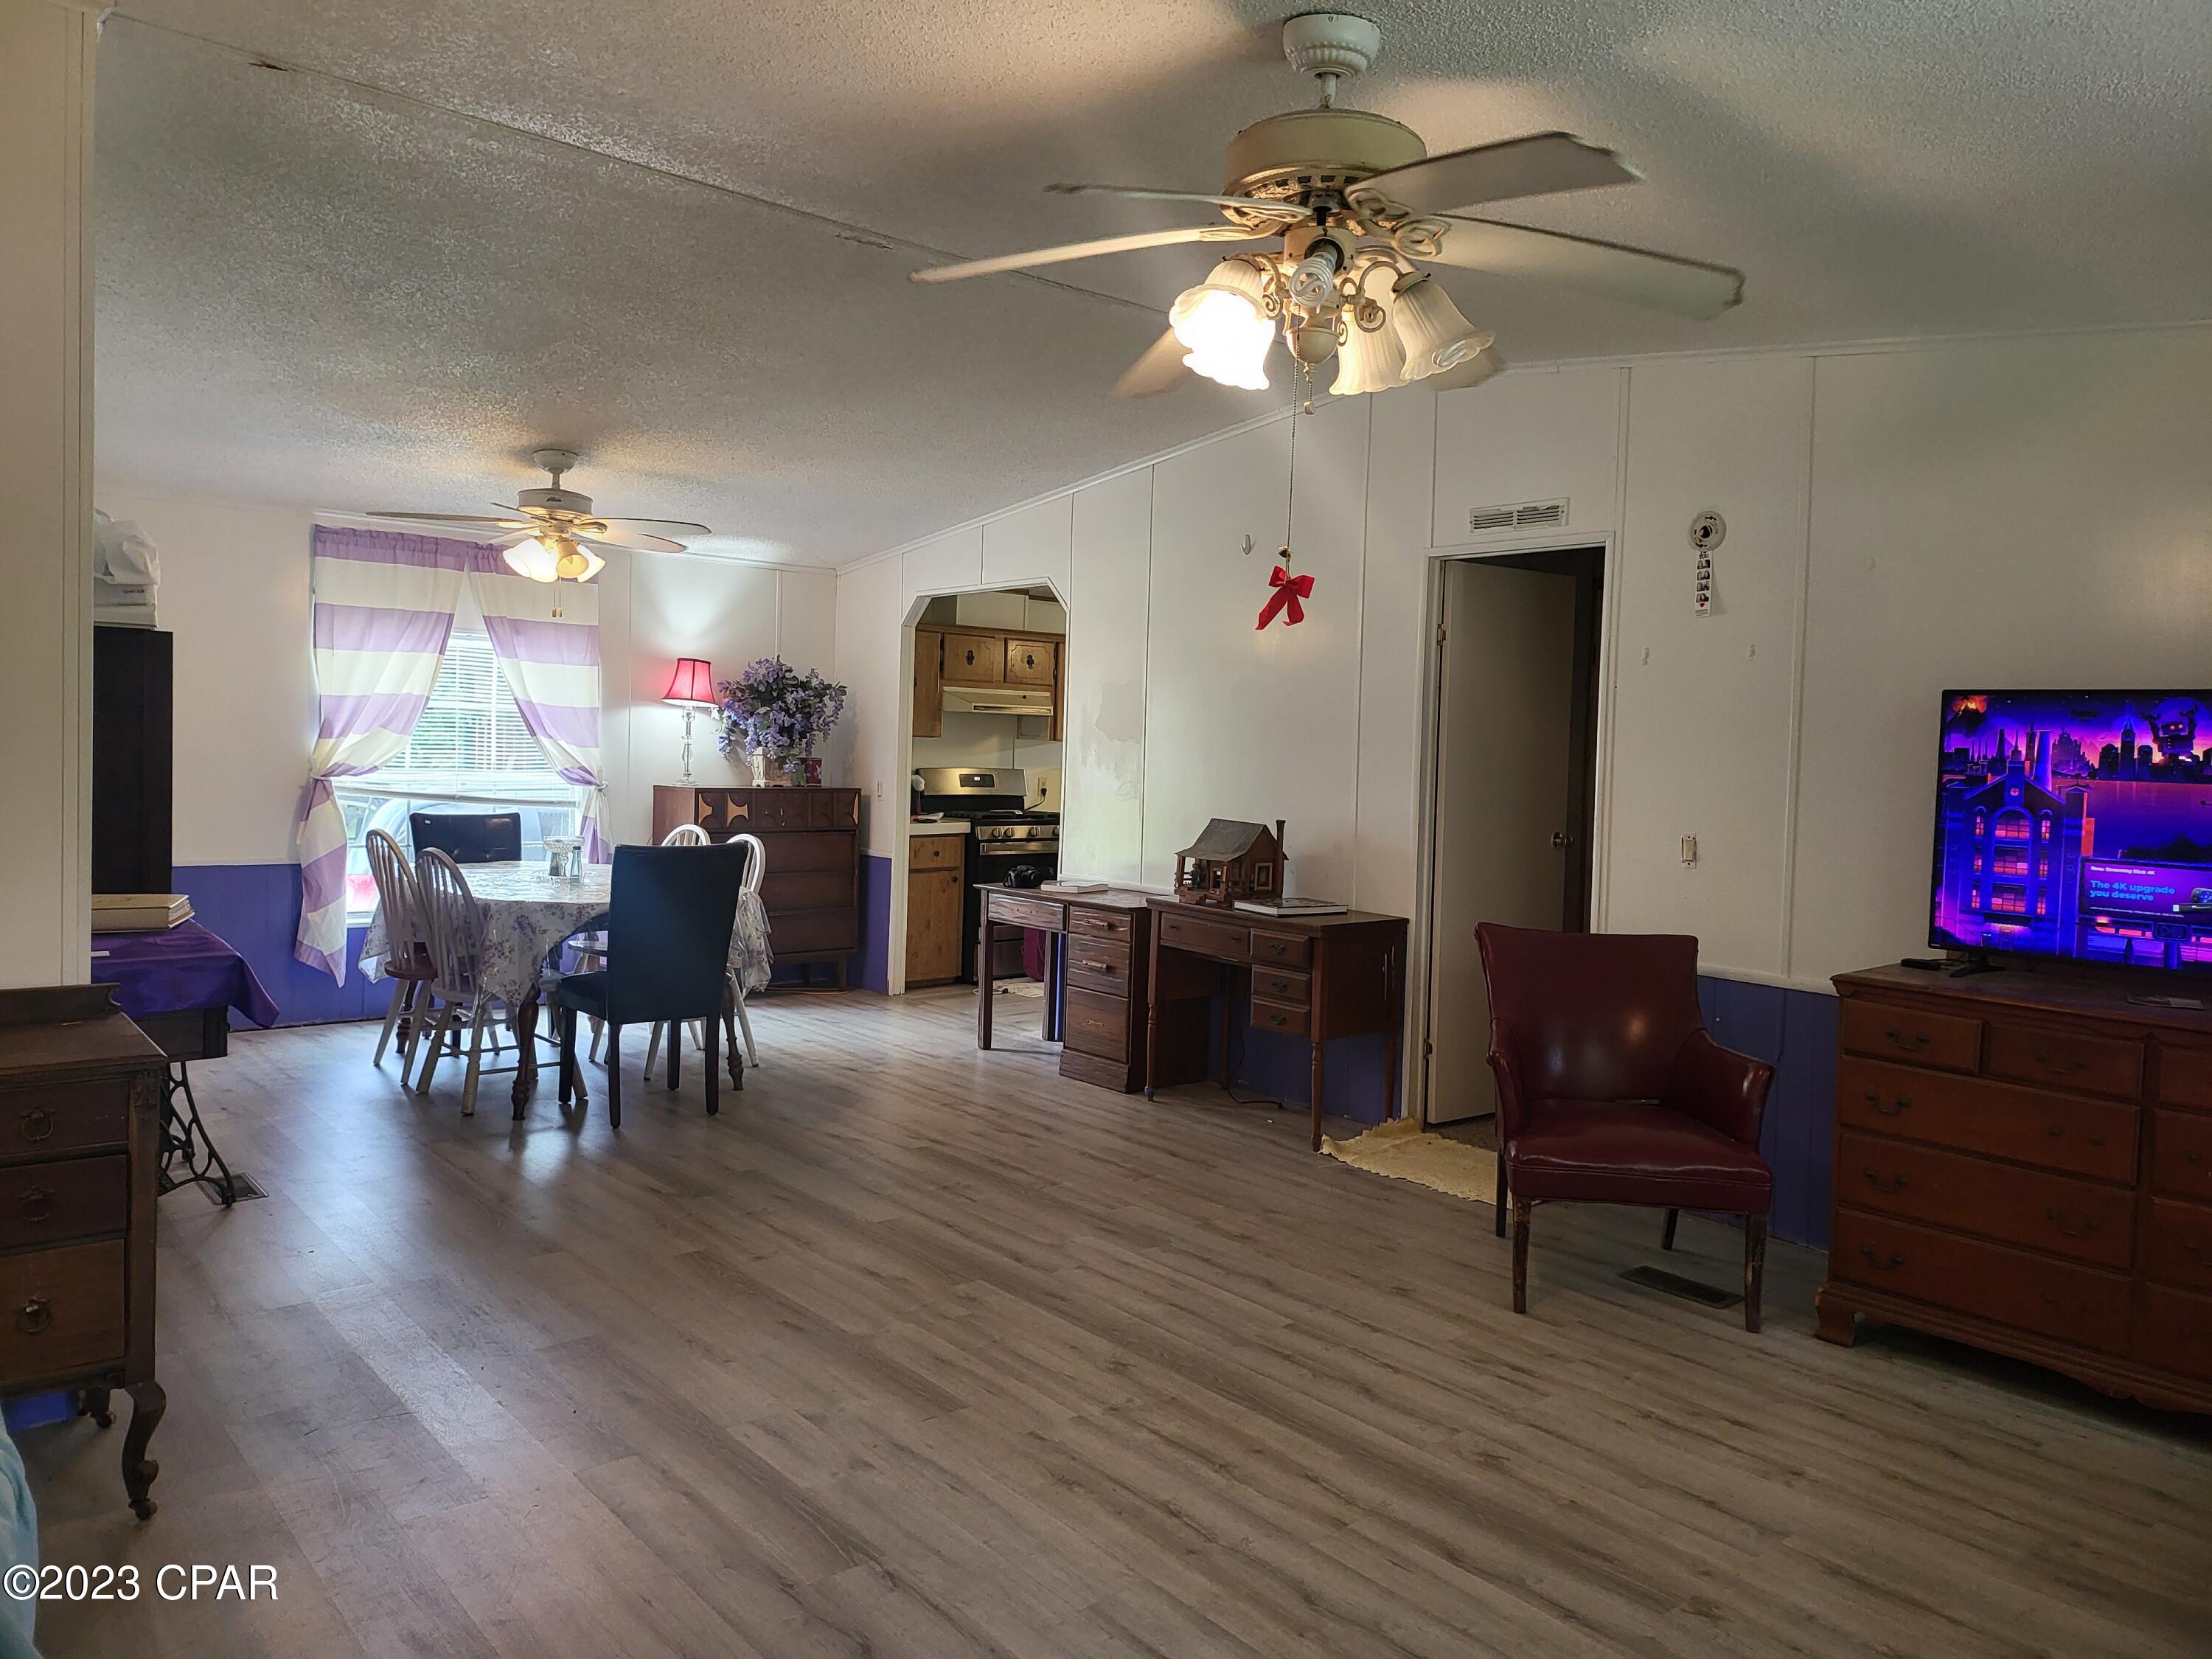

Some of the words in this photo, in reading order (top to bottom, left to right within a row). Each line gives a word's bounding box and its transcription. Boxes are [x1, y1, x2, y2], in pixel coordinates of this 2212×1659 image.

[2090, 880, 2110, 889] The
[2112, 882, 2127, 891] 4K
[2129, 885, 2176, 894] upgrade
[2089, 890, 2110, 898] you
[2111, 891, 2154, 901] deserve
